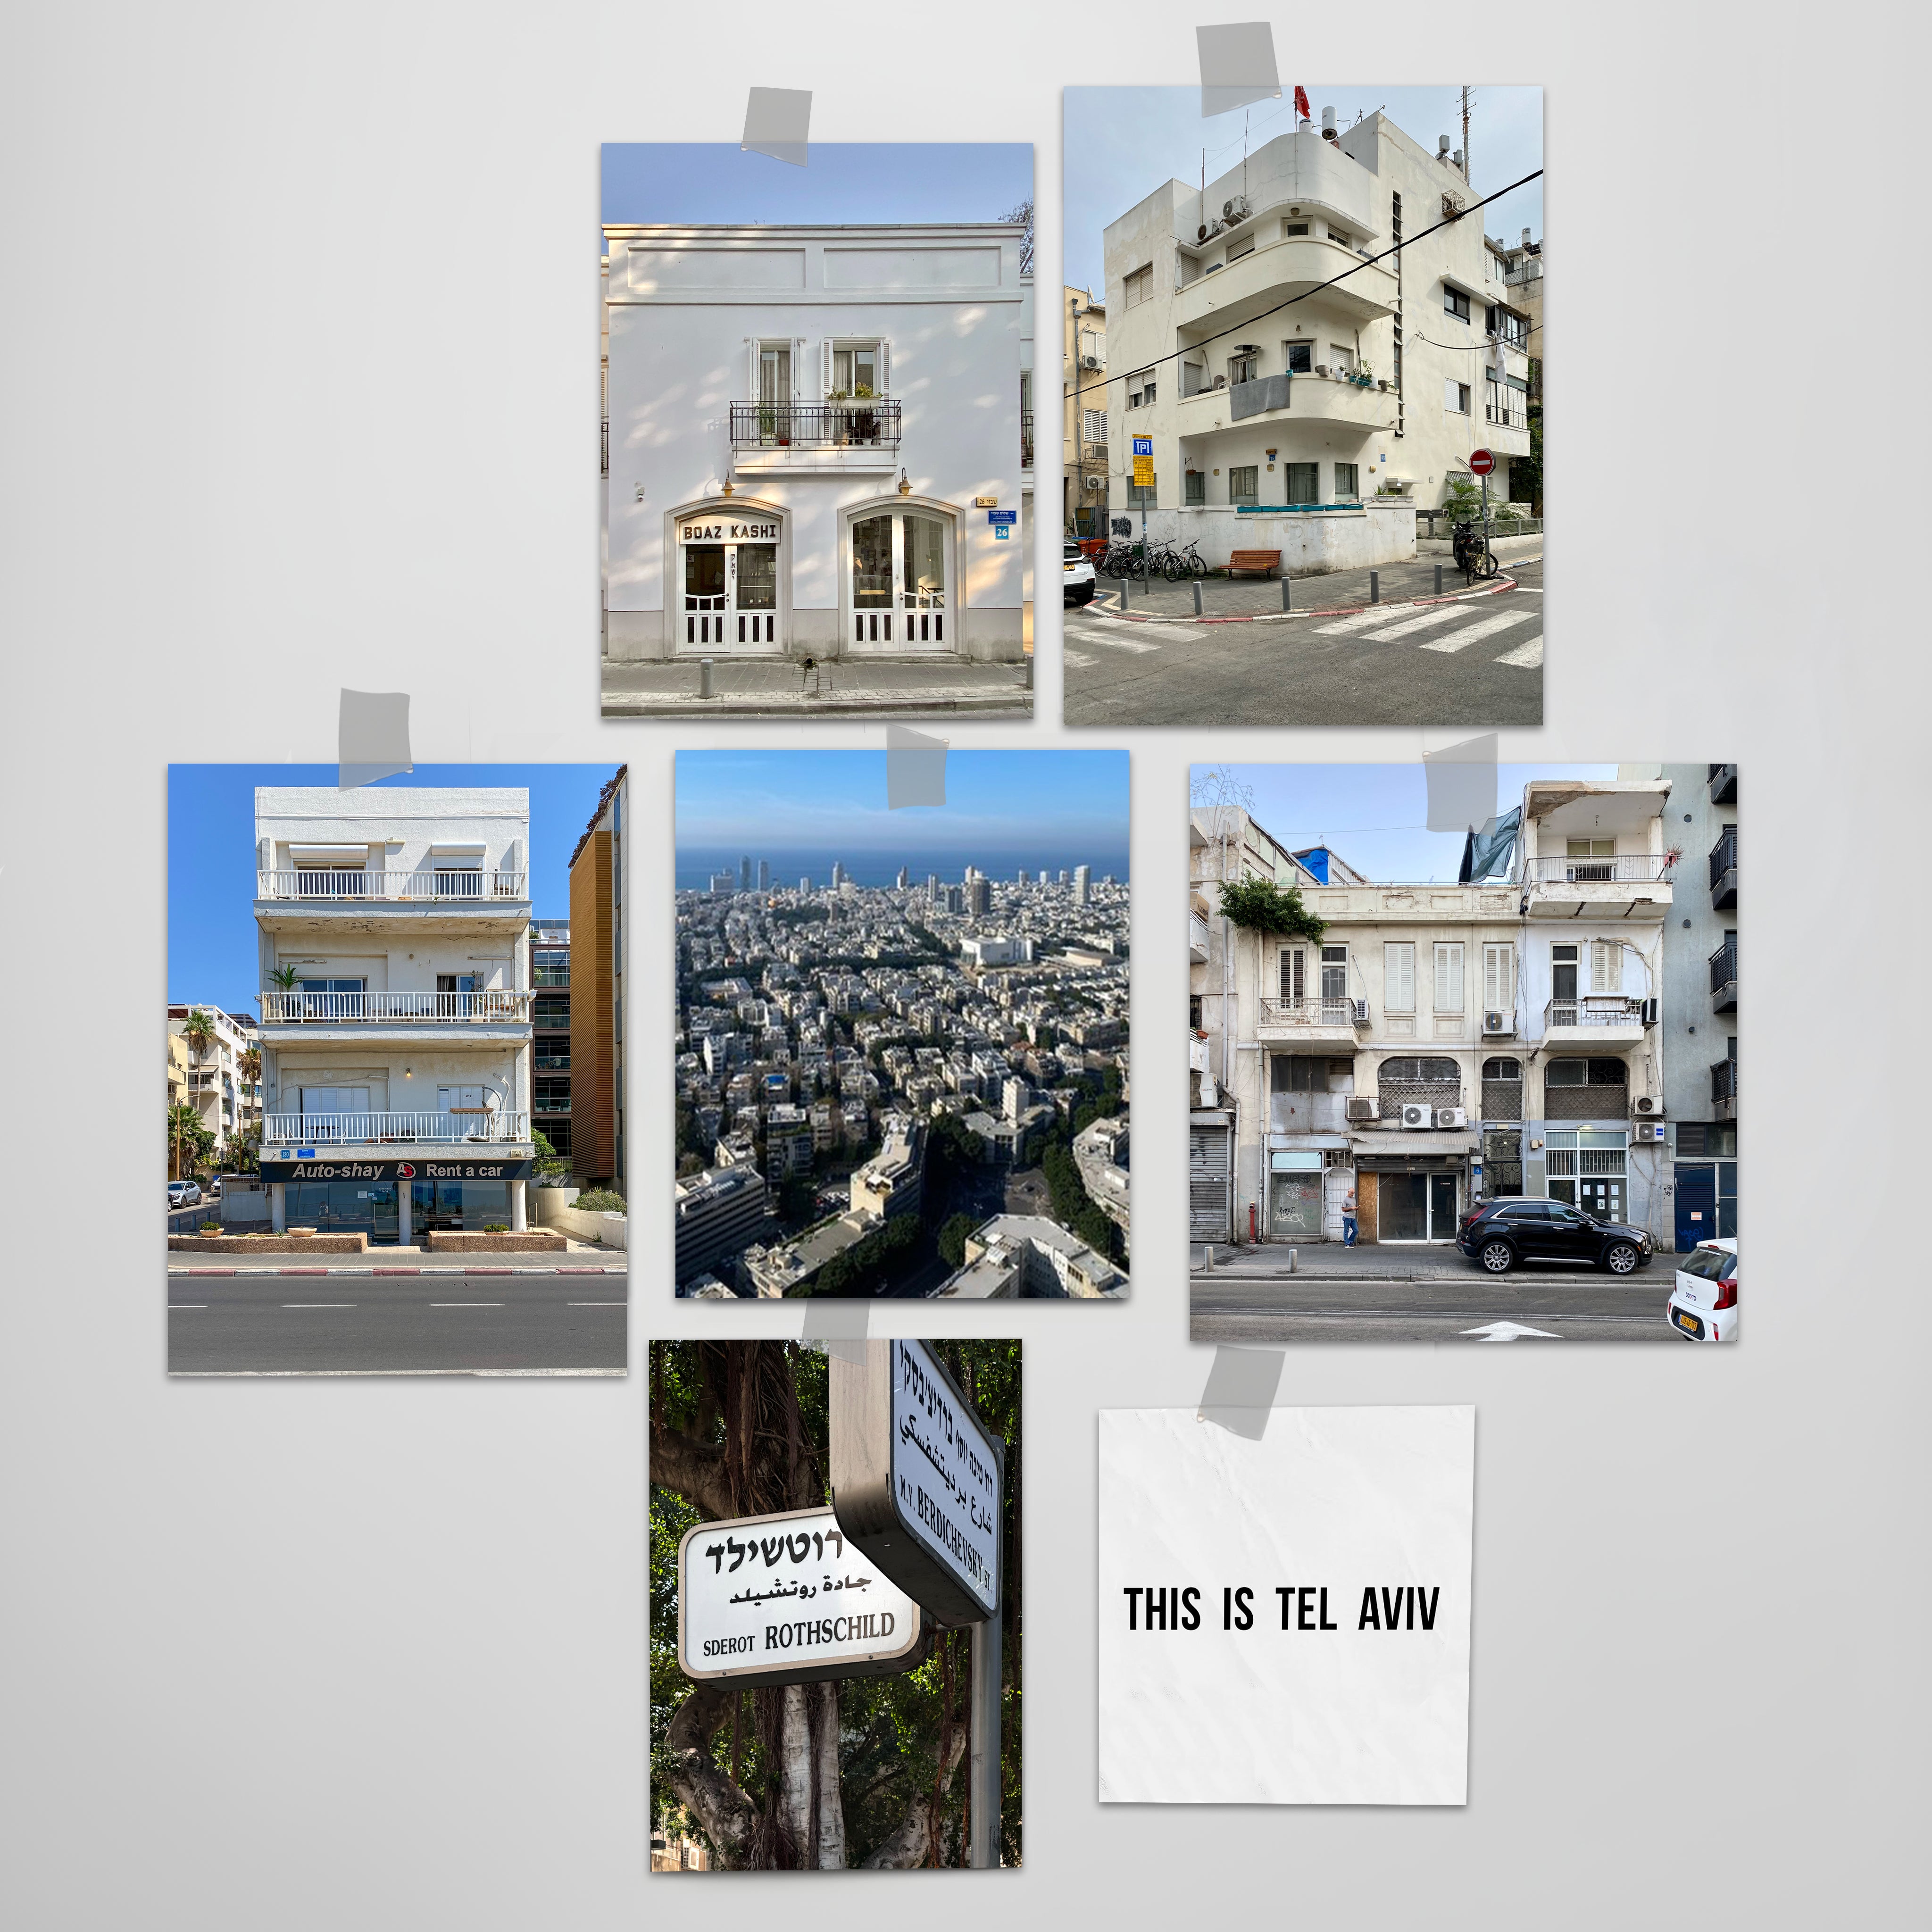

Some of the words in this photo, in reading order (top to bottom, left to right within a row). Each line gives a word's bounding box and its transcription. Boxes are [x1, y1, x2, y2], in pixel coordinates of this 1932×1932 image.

[684, 526, 722, 539] BOAZ
[731, 525, 776, 538] KASHI
[997, 528, 1008, 537] 26
[292, 1163, 384, 1181] Auto-shay
[426, 1163, 462, 1177] Rent
[466, 1166, 475, 1177] a
[478, 1166, 503, 1177] car
[956, 1429, 968, 1464] יוסף
[970, 1449, 983, 1486] מיכה
[918, 1485, 983, 1582] BERDICHEVSKY
[971, 1496, 992, 1535] شارع
[705, 1528, 842, 1574] רוטשילד
[729, 1578, 816, 1606] روتشيلد
[823, 1574, 872, 1592] جادة
[1123, 1587, 1201, 1631] THIS
[1224, 1587, 1254, 1631] IS
[1275, 1587, 1338, 1630] TEL
[1357, 1586, 1440, 1630] AVIV
[703, 1635, 755, 1657] SDEROT
[765, 1612, 894, 1649] ROTHSCHILD
